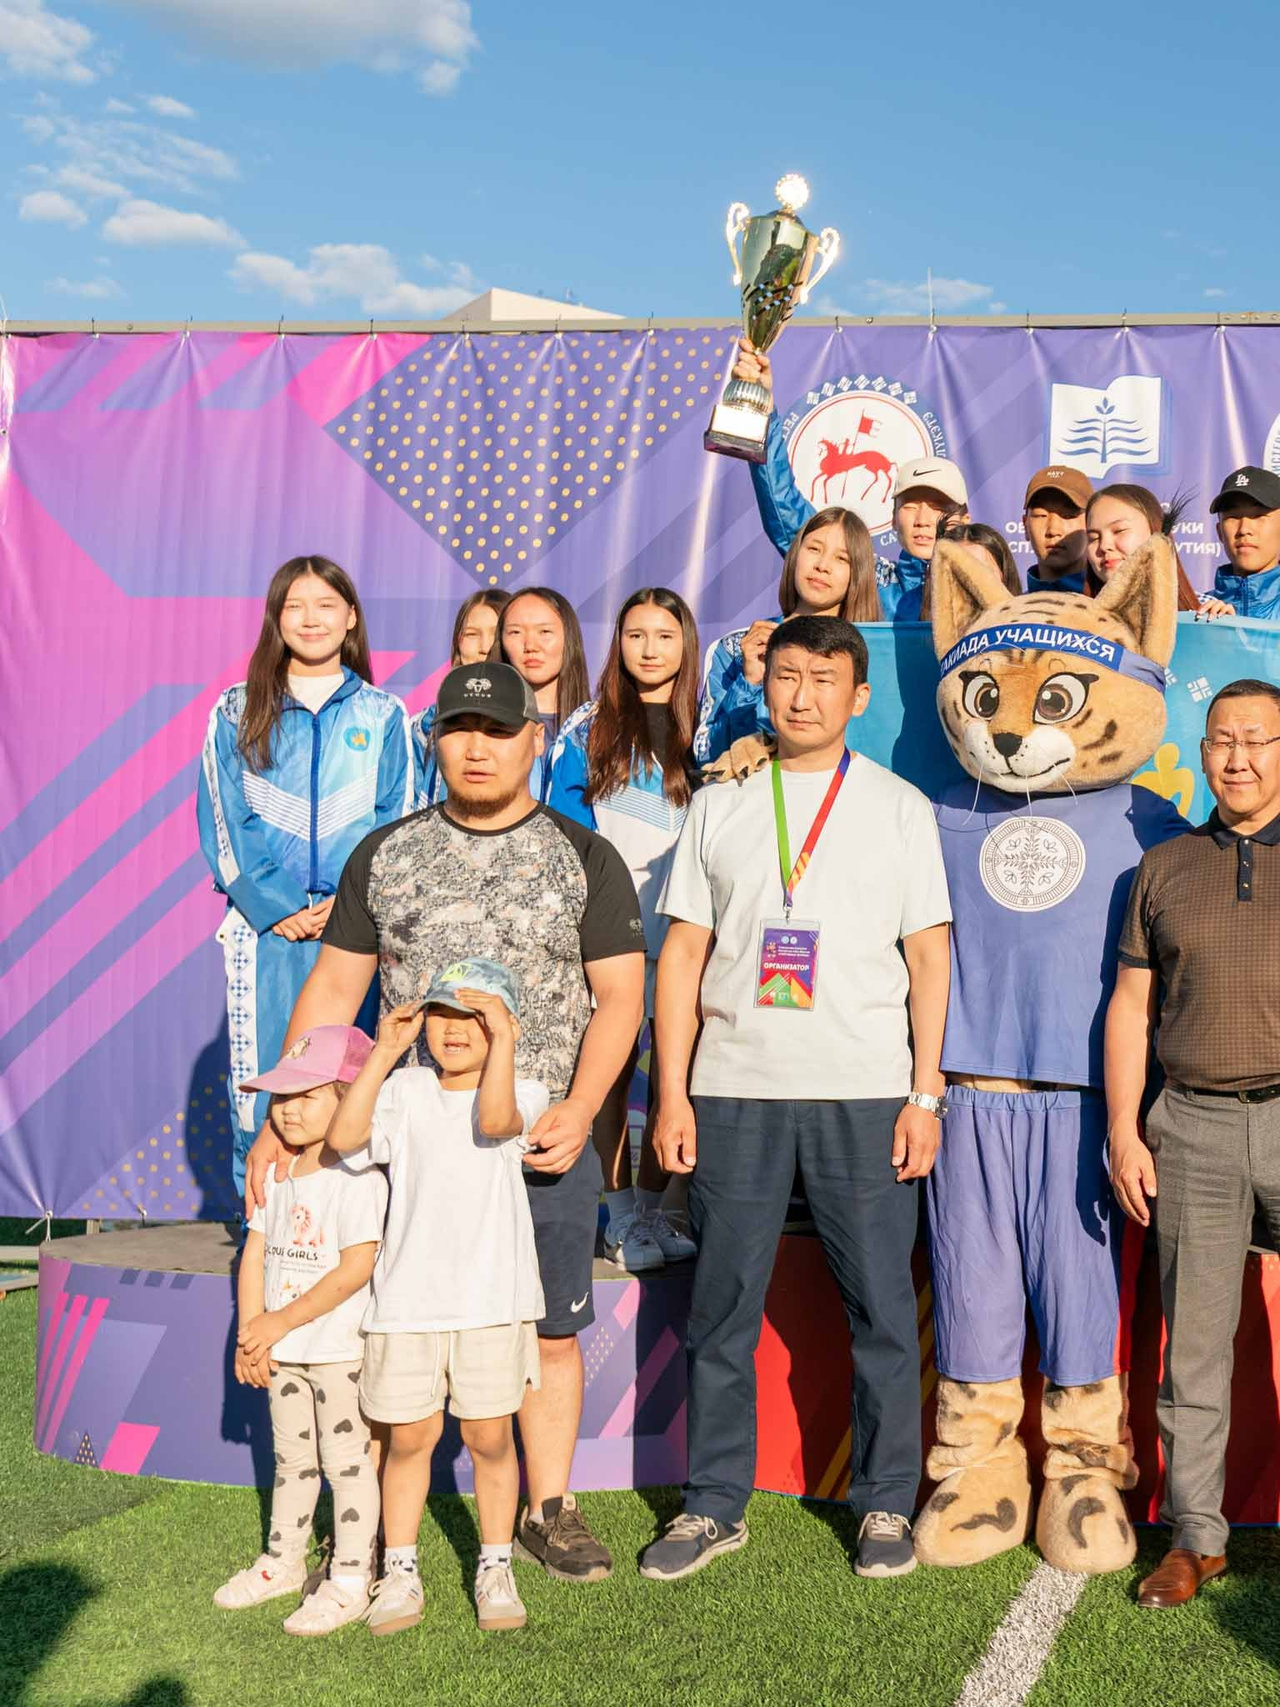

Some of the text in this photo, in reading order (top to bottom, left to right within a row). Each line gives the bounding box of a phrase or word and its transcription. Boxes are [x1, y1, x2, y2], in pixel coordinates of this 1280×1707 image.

[1172, 522, 1204, 534] УКИ
[880, 531, 898, 546] СА
[1175, 542, 1221, 557] УТИЯ)
[995, 627, 1115, 662] УЧАЩИХСЯ
[763, 962, 810, 972] ОРГАНИЗАТОР
[287, 1248, 318, 1261] GIRLS
